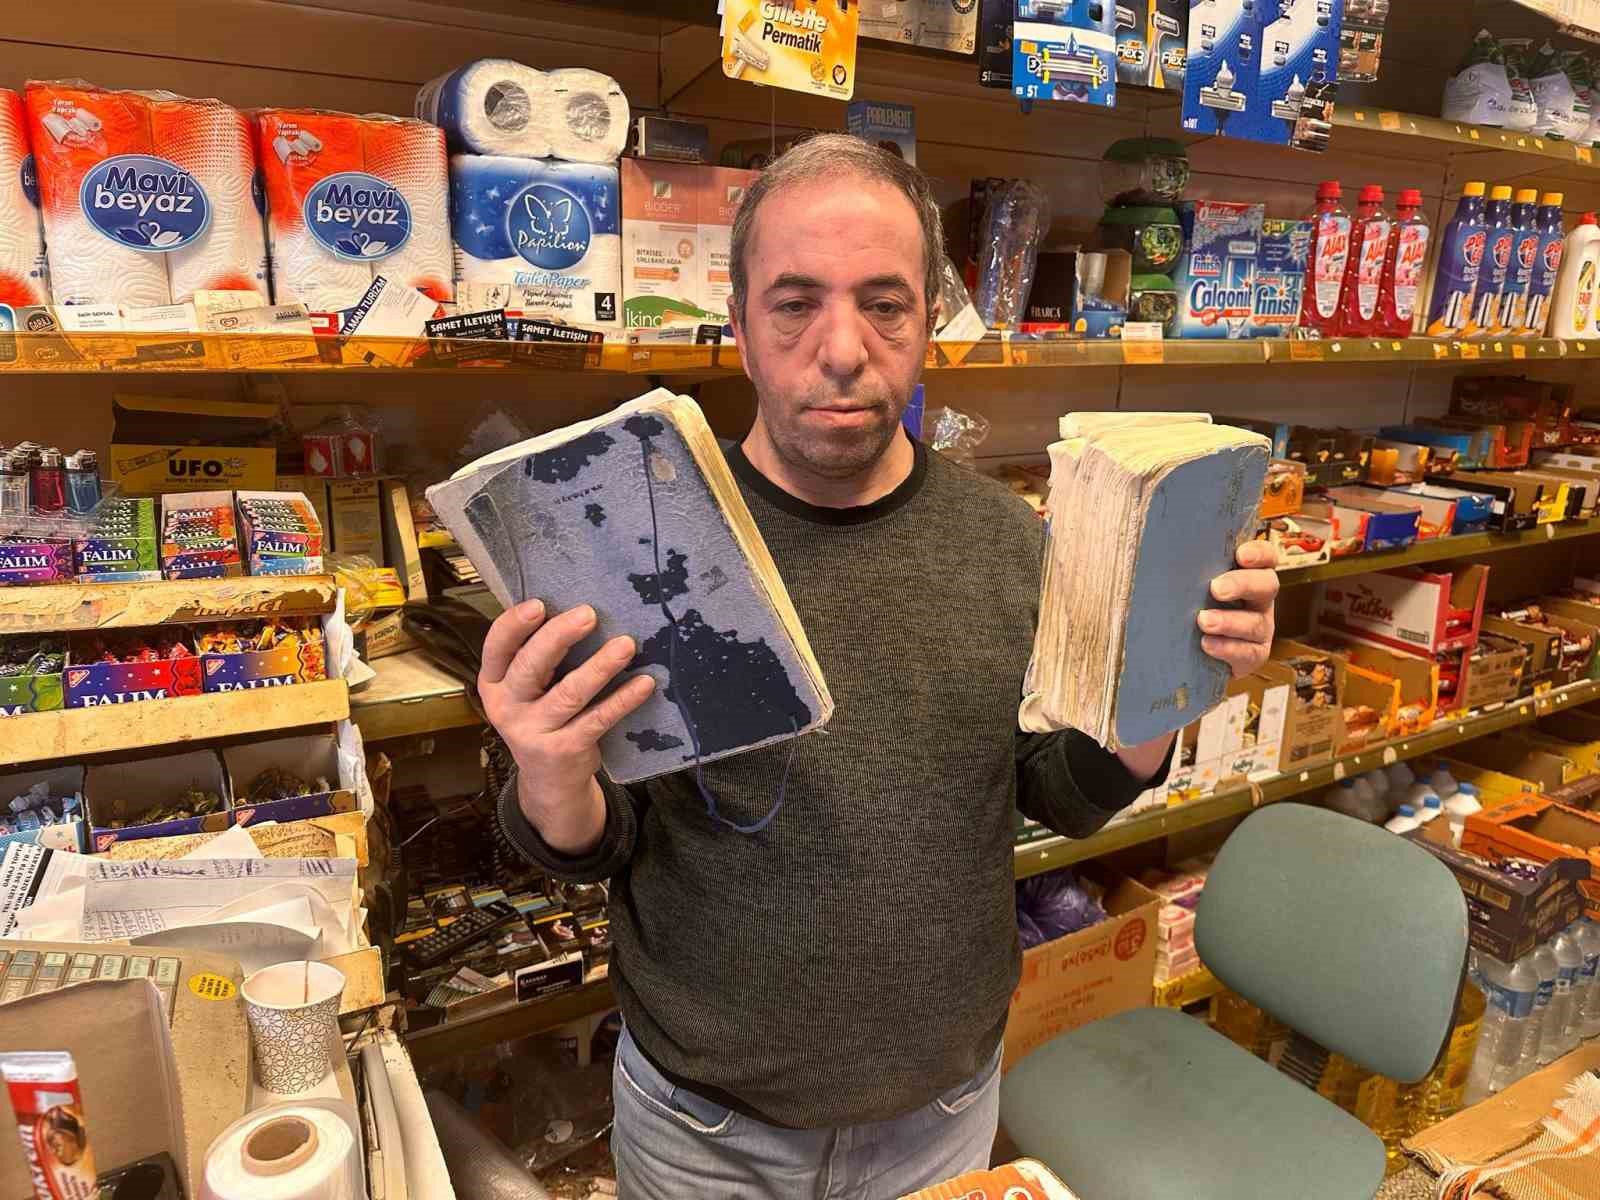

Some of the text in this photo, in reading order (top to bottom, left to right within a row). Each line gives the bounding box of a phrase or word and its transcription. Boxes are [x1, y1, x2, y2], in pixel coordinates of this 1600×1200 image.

[762, 3, 828, 33] Gillette
[763, 22, 822, 54] Permatik
[104, 166, 190, 195] Mavi
[94, 183, 194, 218] beyaz
[324, 183, 396, 208] Mavi
[316, 199, 401, 230] beyaz
[361, 278, 386, 310] TURİZM
[601, 295, 612, 311] 4
[1191, 279, 1252, 312] Calgonit
[1256, 284, 1300, 316] finish
[430, 321, 461, 334] SAMET
[463, 311, 503, 328] İLETİŞİM
[521, 324, 552, 337] SAMET
[552, 326, 589, 343] İLETİŞİM
[169, 459, 223, 477] UFO
[82, 549, 132, 562] FALIM
[257, 540, 301, 552] FALIM
[0, 556, 48, 568] FALIM
